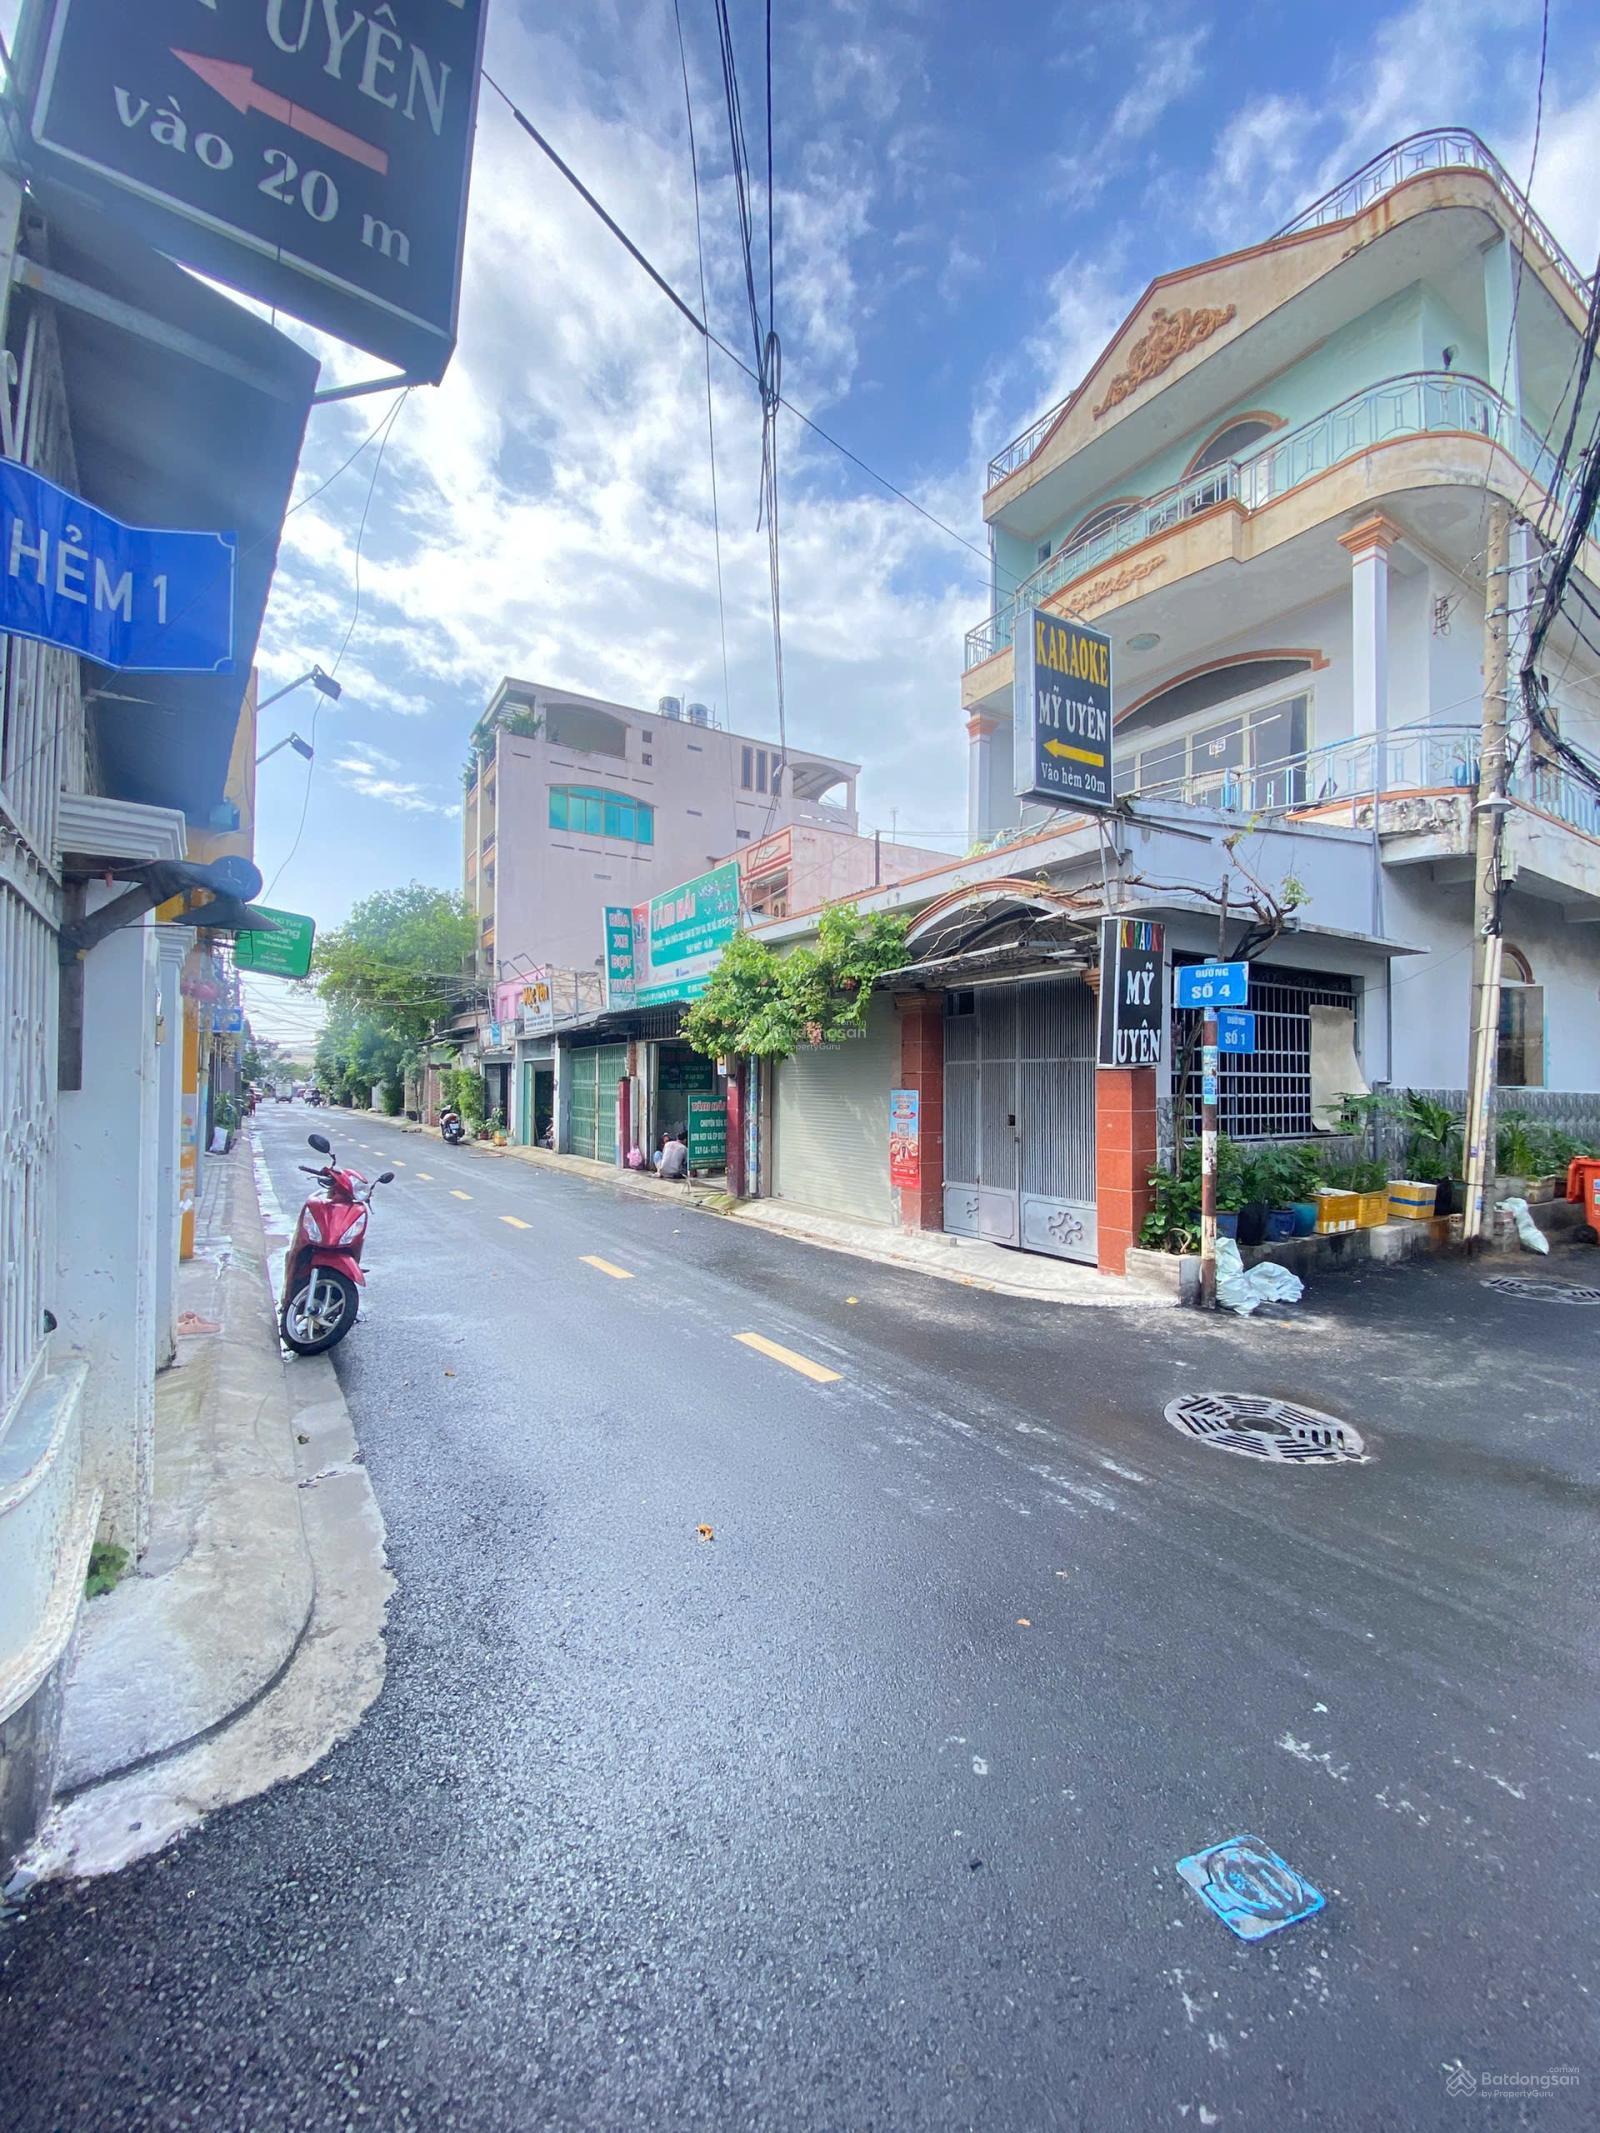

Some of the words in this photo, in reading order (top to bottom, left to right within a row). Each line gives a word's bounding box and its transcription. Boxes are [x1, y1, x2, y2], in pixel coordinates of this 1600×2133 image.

[267, 0, 452, 136] UYÊN
[113, 85, 234, 171] vào
[258, 148, 339, 223] 20
[361, 213, 410, 267] m
[8, 517, 133, 623] HẺM
[152, 574, 168, 625] 1
[1035, 619, 1109, 689] KARAOKE
[1038, 686, 1062, 729] MỸ
[1065, 696, 1107, 742] UYÊN
[1041, 762, 1060, 782] Vào
[1084, 773, 1106, 794] 20m
[610, 954, 633, 973] BỌT
[1126, 962, 1155, 1006] MỸ
[1195, 966, 1230, 978] ĐƯỜNG
[1191, 980, 1214, 999] SỐ
[1218, 983, 1232, 998] 4
[1116, 1019, 1161, 1064] UYÊN
[1224, 1029, 1238, 1045] SỐ
[1240, 1033, 1246, 1045] 1
